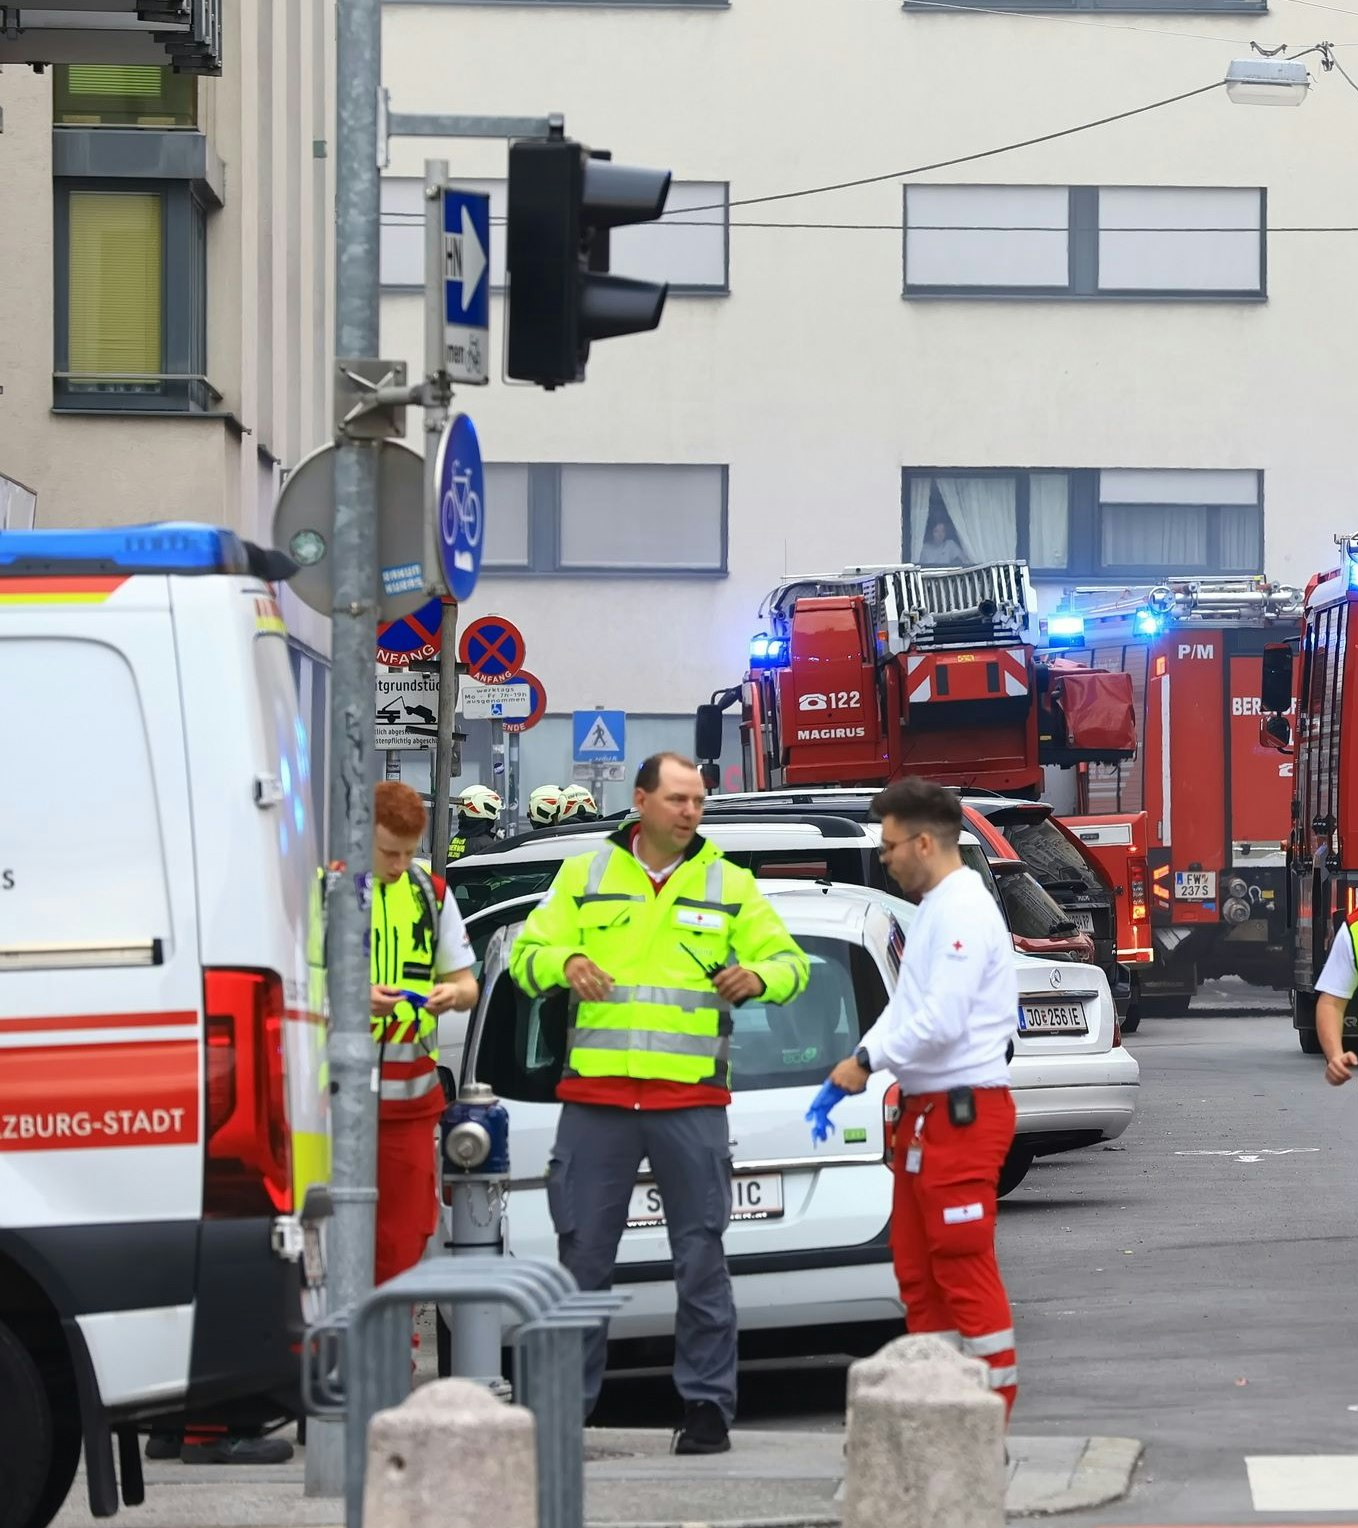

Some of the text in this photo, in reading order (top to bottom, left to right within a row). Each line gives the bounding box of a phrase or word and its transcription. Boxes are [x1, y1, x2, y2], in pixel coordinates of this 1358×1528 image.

[1178, 644, 1214, 659] P/M
[474, 671, 512, 684] ANFANG
[828, 691, 861, 709] 122
[502, 722, 526, 732] ENDE
[797, 727, 865, 740] MAGIRUS
[1187, 874, 1201, 885] FW
[1181, 885, 1200, 896] 237
[1027, 1009, 1041, 1026] JO
[0, 1107, 185, 1140] ZBURG-STADT
